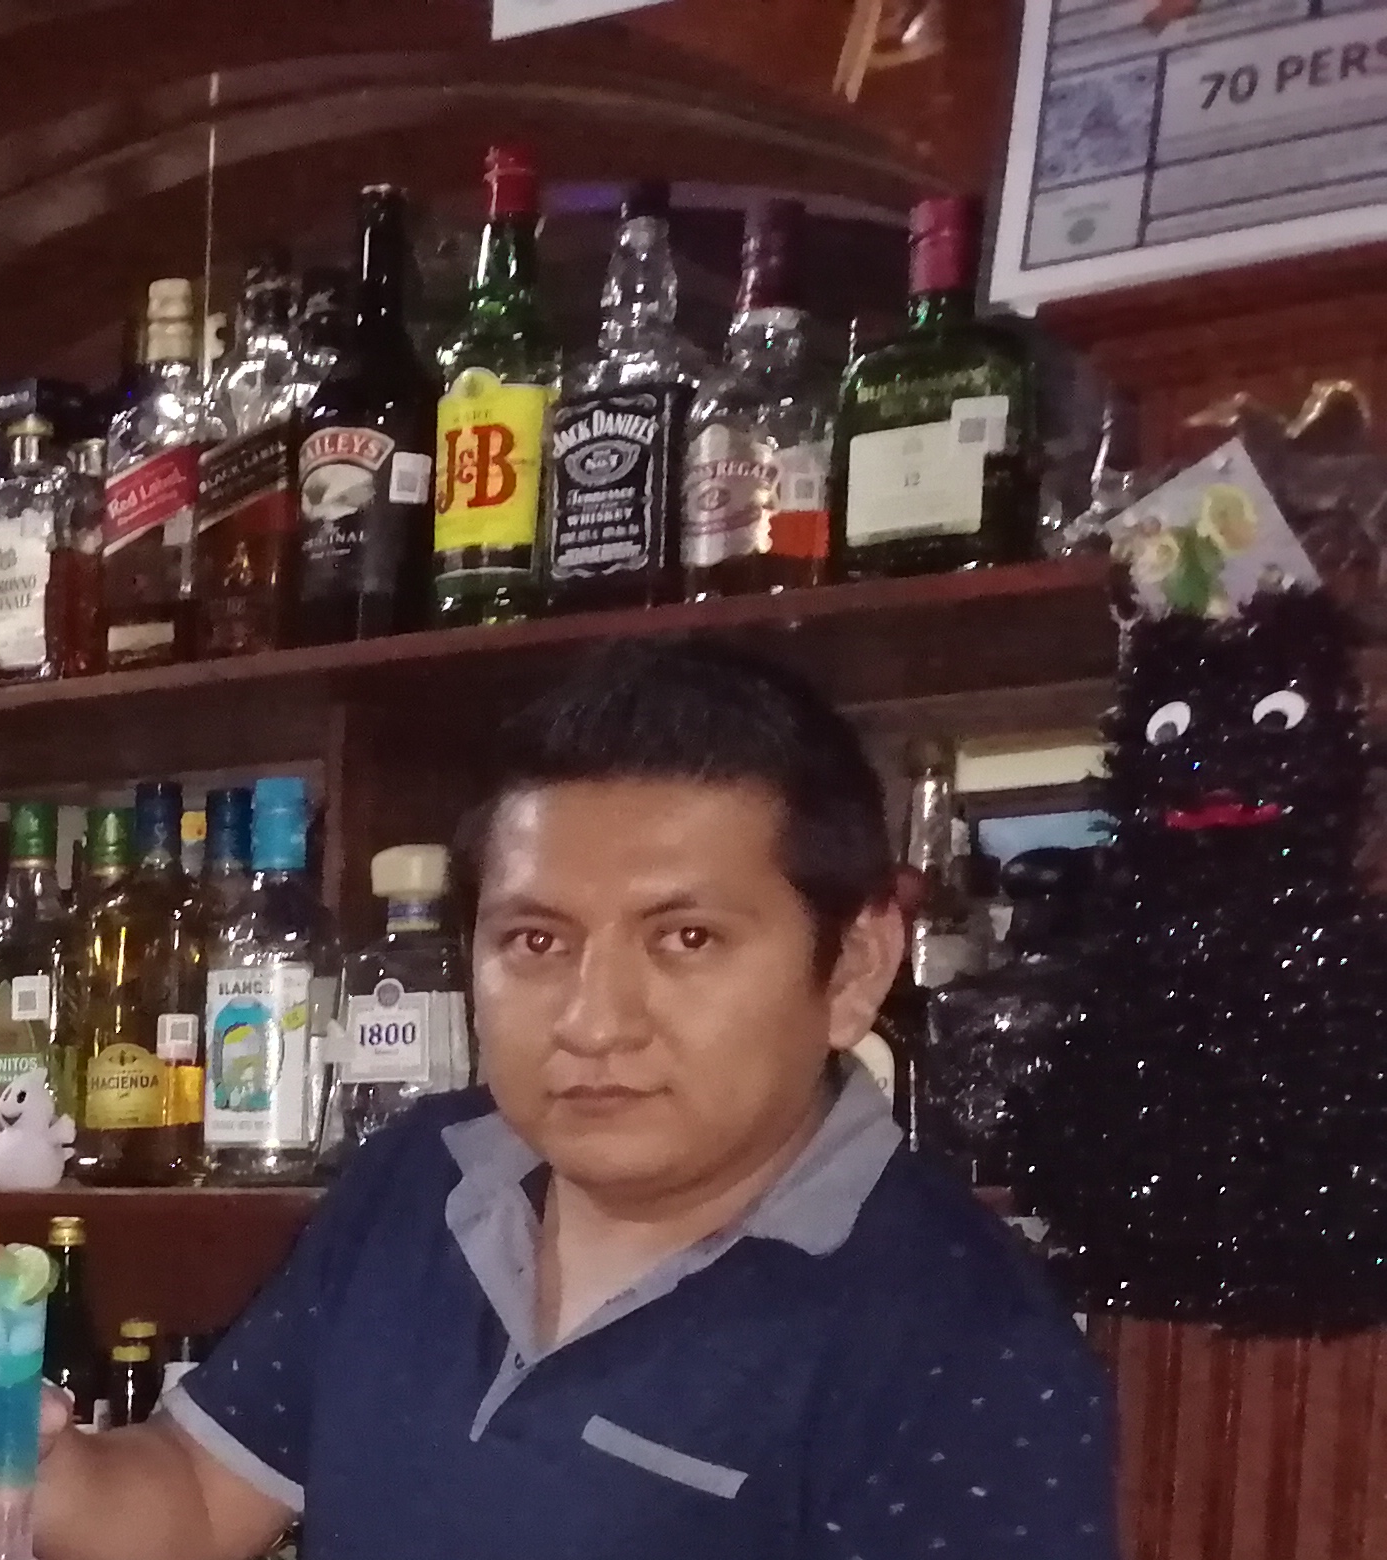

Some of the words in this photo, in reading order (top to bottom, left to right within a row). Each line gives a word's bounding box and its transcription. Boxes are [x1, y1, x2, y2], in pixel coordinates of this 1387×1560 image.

[1199, 66, 1258, 111] 70
[305, 432, 380, 460] AILEYS
[553, 421, 593, 459] JACK
[436, 423, 518, 515] J&B
[358, 1021, 417, 1046] 1800
[90, 1074, 160, 1091] HACIENDA
